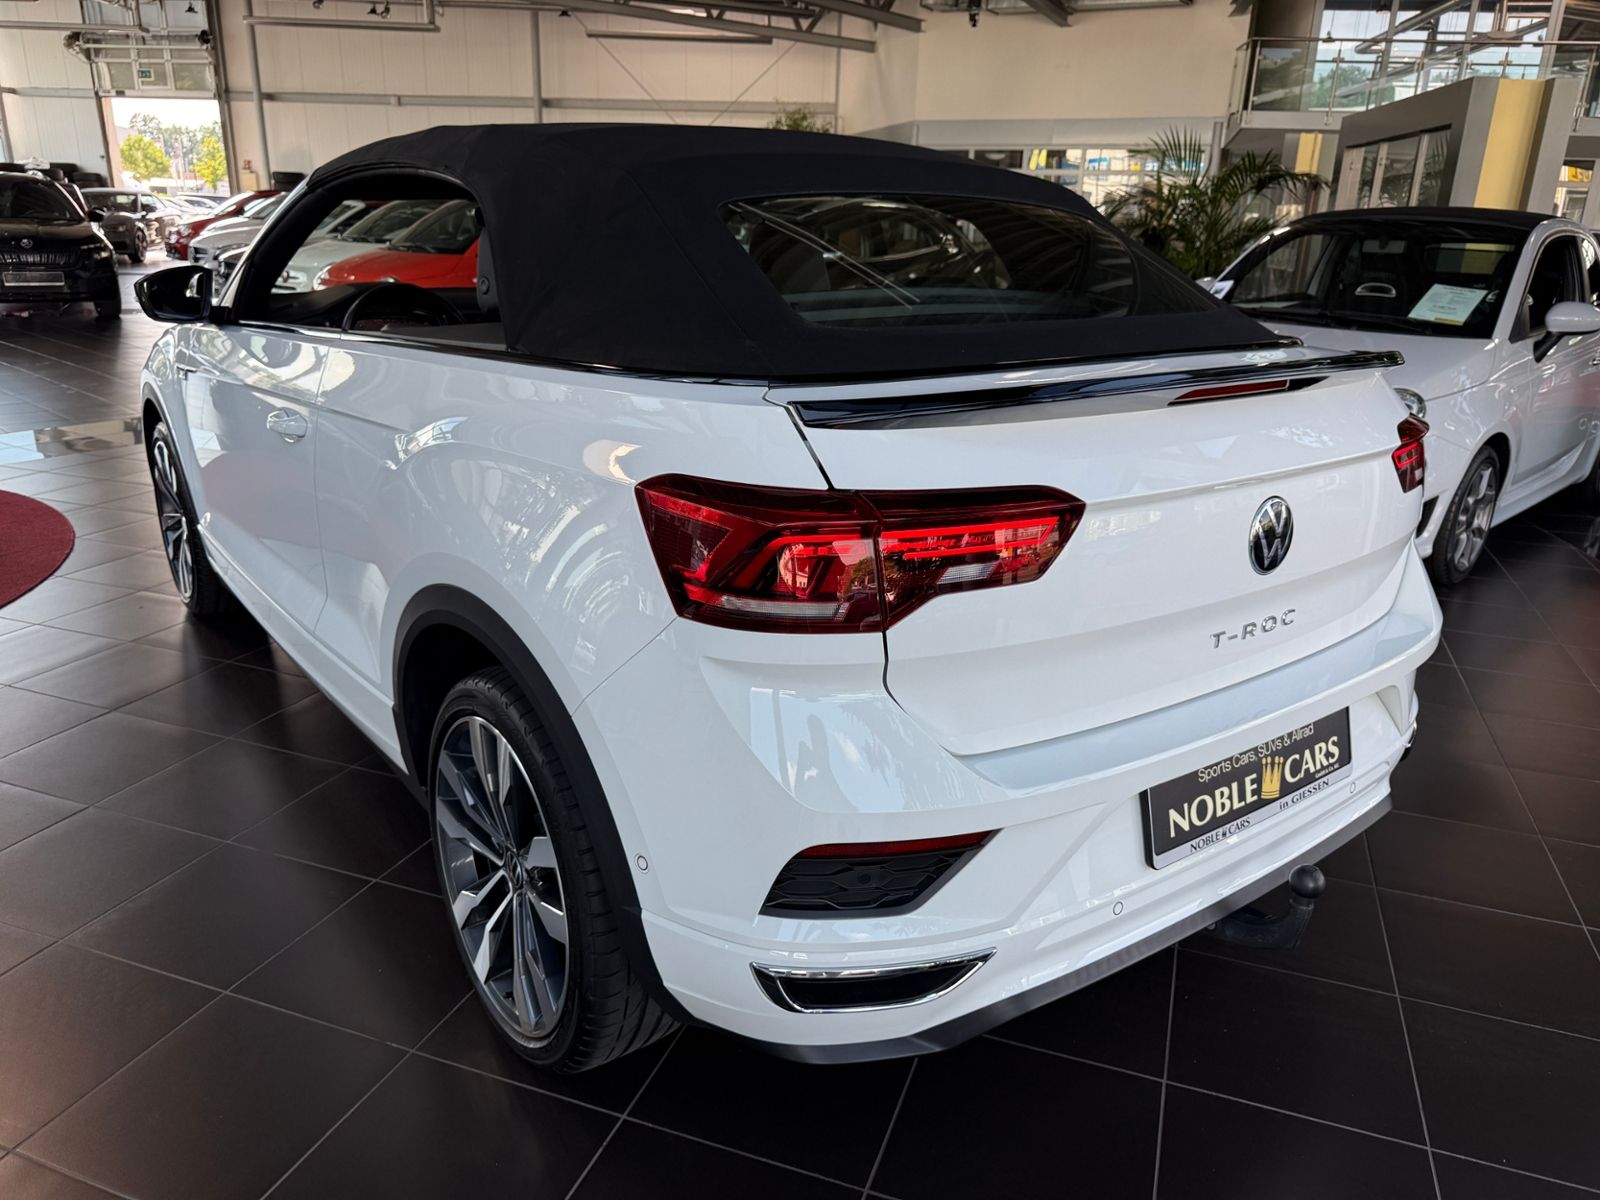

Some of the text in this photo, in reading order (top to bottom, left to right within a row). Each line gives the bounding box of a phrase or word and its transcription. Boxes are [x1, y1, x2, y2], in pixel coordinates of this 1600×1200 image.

[1249, 495, 1293, 575] VW
[1210, 608, 1296, 649] T-ROC
[1197, 760, 1232, 783] Sports
[1232, 750, 1258, 768] Cars,
[1257, 739, 1282, 757] SUVs
[1282, 733, 1290, 747] &
[1168, 735, 1340, 839] NOBLE CARS
[1279, 778, 1330, 810] in GIESSEN
[1190, 817, 1252, 853] NOBLE CARS
